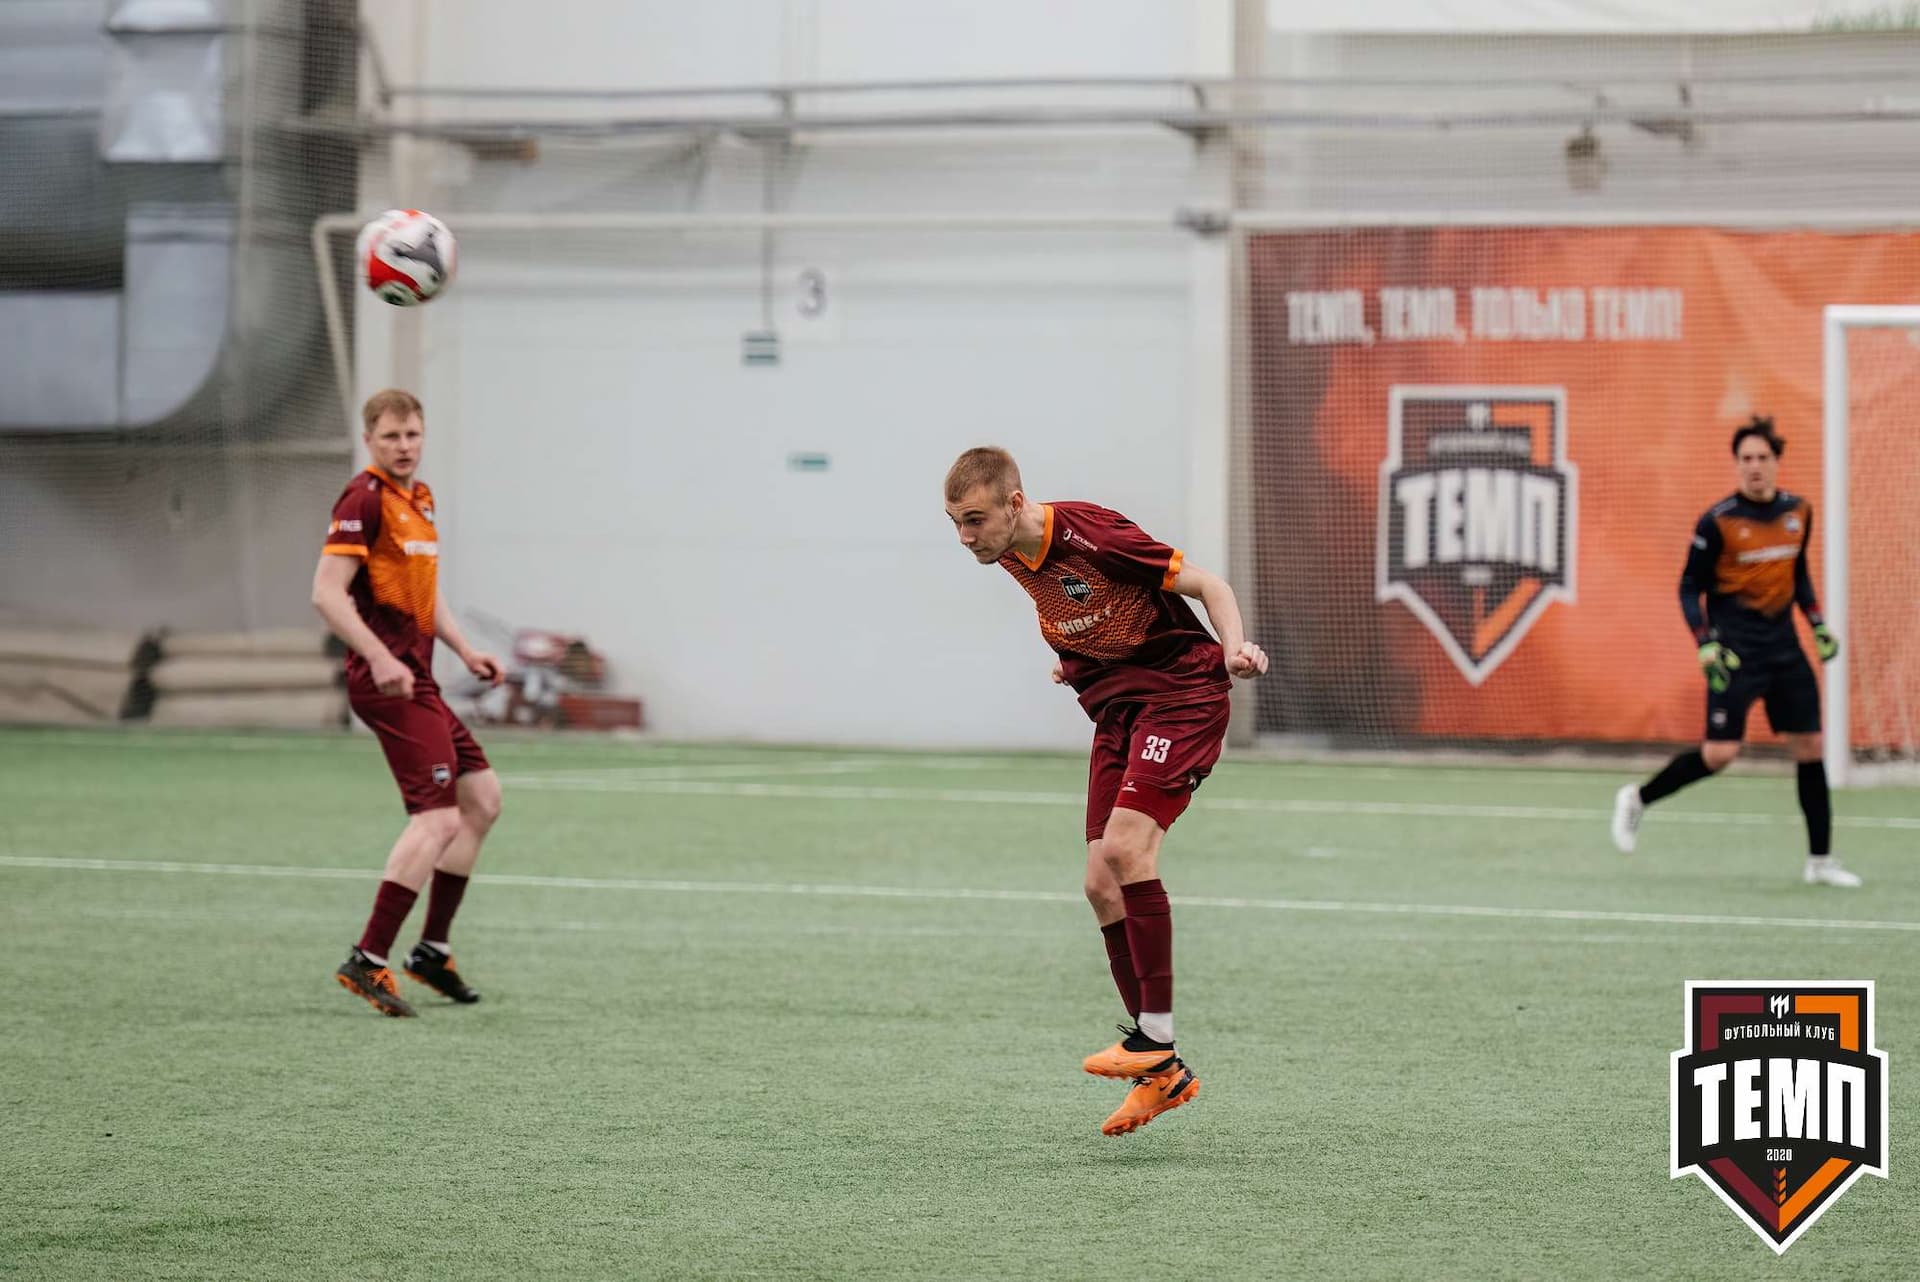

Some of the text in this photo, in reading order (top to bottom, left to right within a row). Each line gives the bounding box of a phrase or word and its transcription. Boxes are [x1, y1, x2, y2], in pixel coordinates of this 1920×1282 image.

[798, 267, 826, 318] 3
[1286, 290, 1376, 346] ТЕМП,
[1380, 287, 1466, 344] ТЕМП,
[1471, 287, 1586, 341] ТОЛЬКО
[1395, 468, 1560, 573] ТЕМП
[1141, 735, 1172, 764] 33
